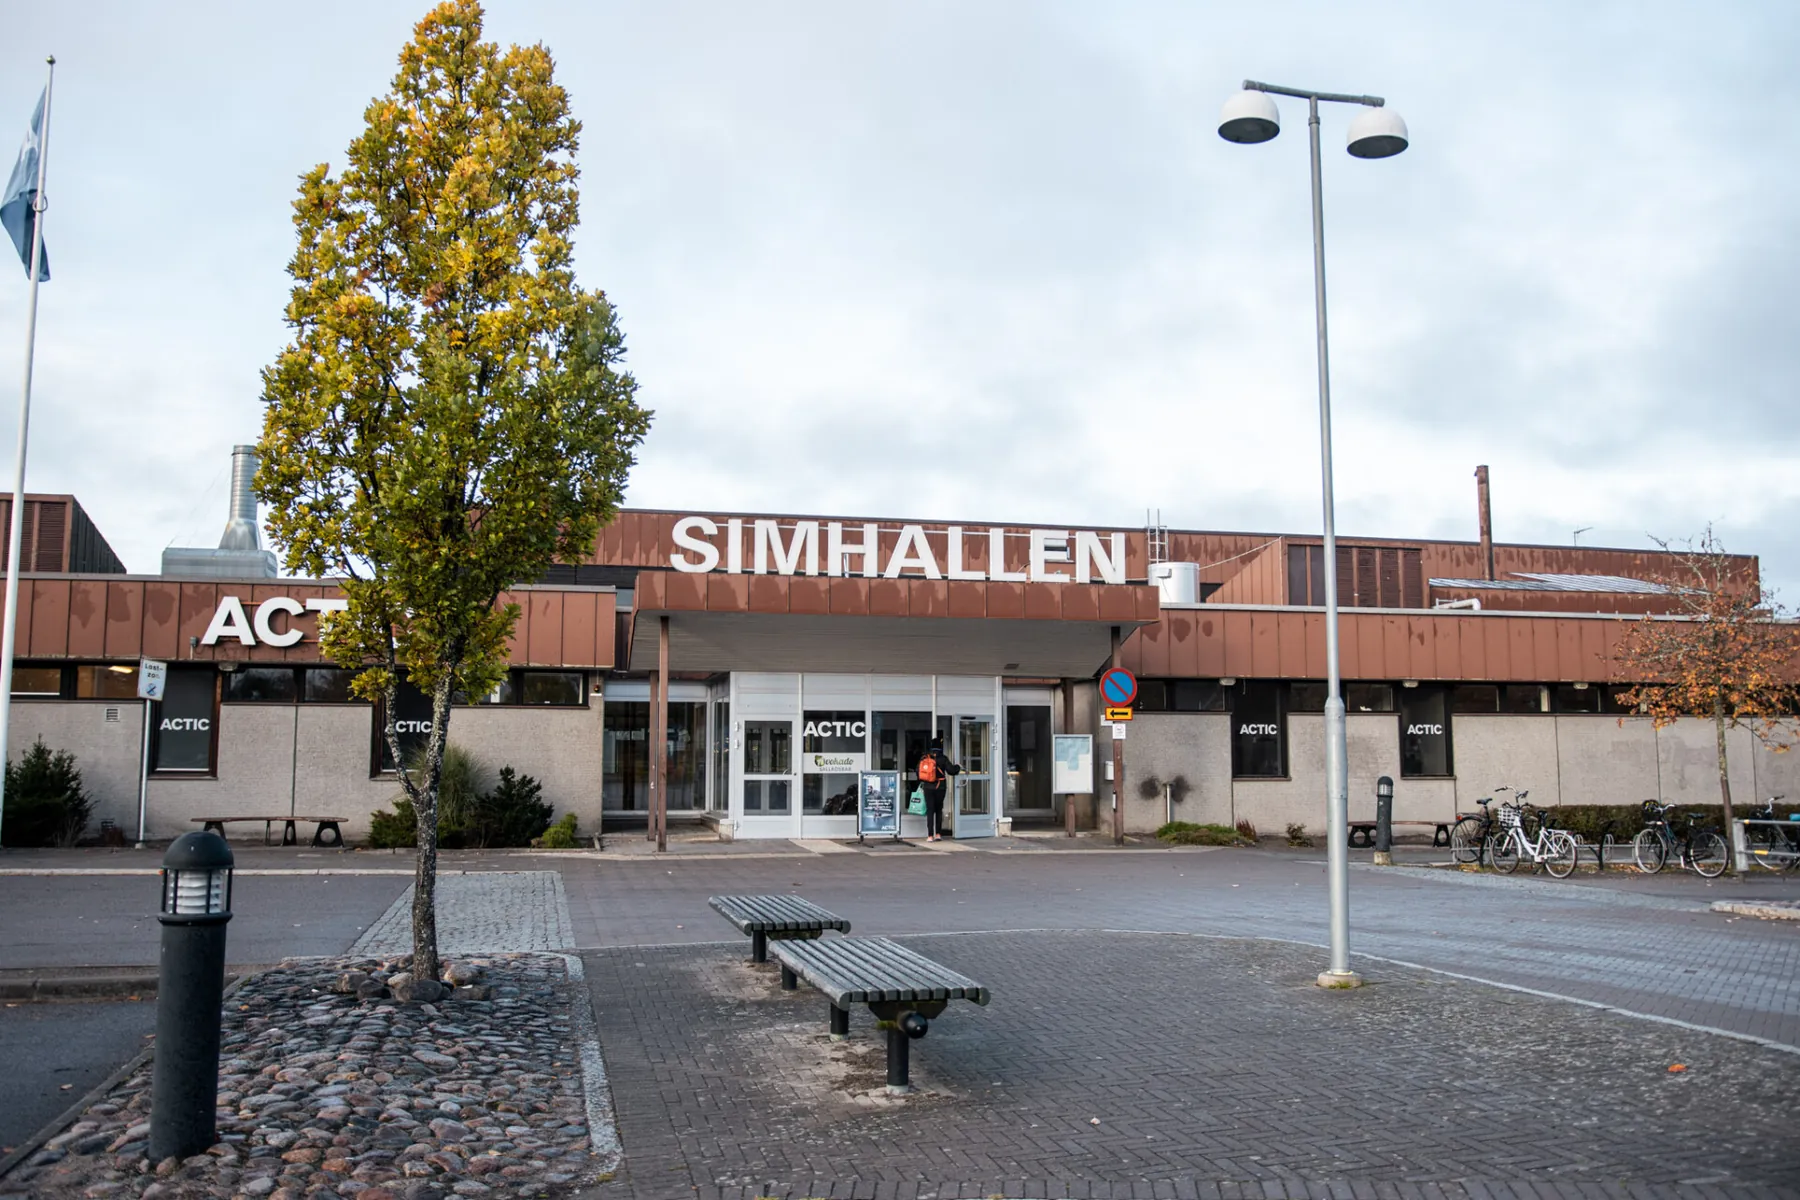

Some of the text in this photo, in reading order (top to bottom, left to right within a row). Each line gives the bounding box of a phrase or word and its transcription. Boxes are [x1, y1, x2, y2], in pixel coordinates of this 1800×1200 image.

[669, 516, 1125, 584] SIMHALLEN
[201, 596, 412, 649] ACT
[160, 718, 210, 730] ACTIC
[803, 721, 866, 738] ACTIC
[1240, 724, 1277, 735] ACTIC
[1407, 724, 1443, 735] ACTIC
